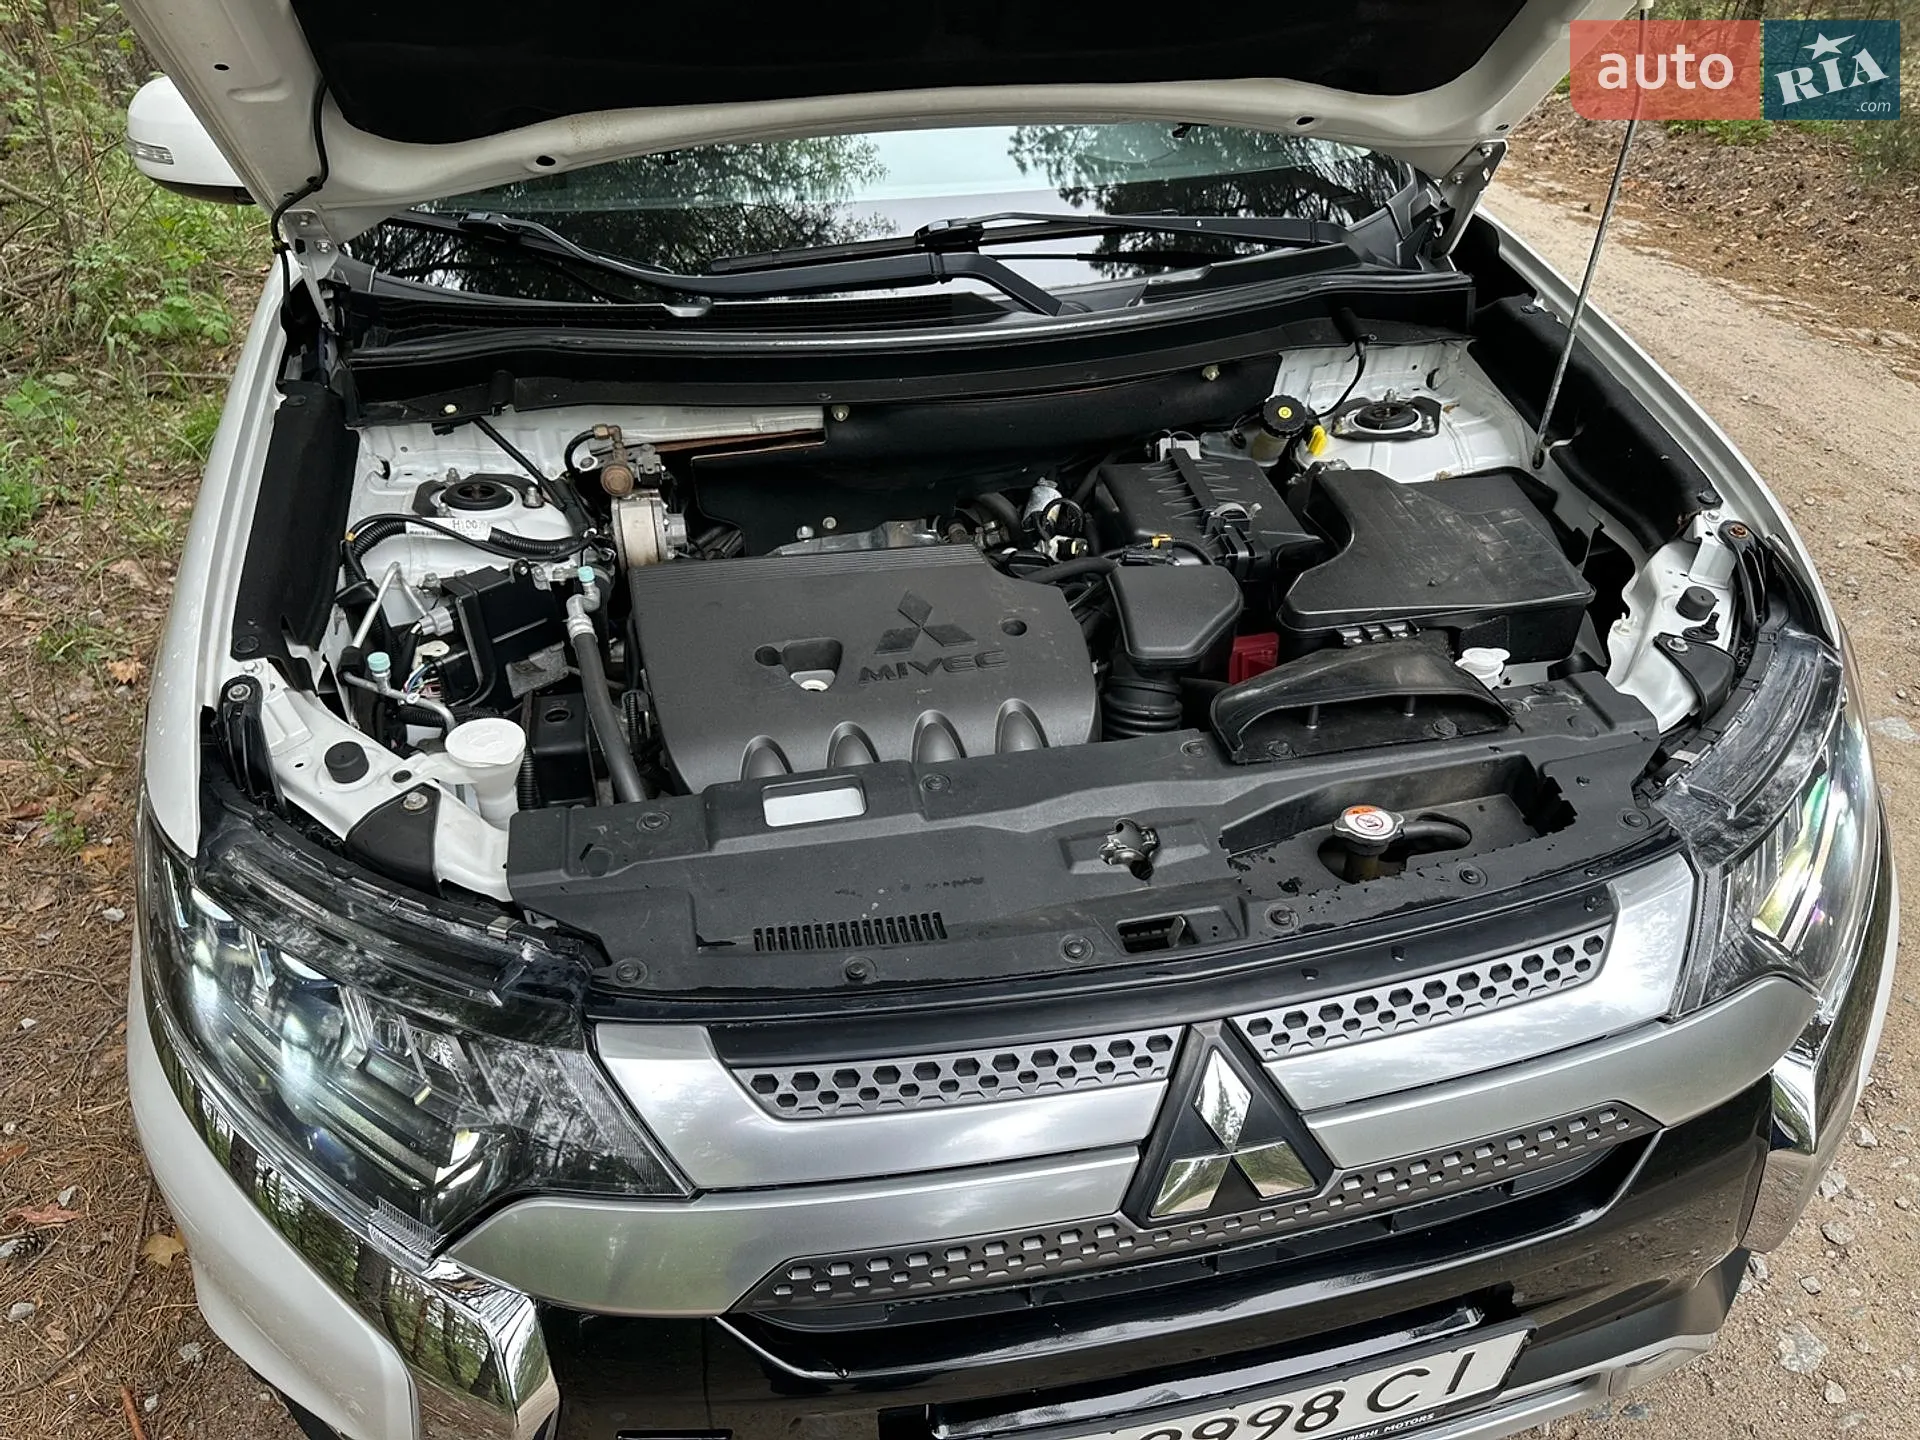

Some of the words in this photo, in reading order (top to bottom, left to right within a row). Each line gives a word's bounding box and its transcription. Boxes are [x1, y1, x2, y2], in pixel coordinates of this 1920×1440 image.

[858, 650, 1008, 685] MIVEC
[1138, 1389, 1347, 1440] 998
[1383, 1412, 1435, 1433] MOTORS
